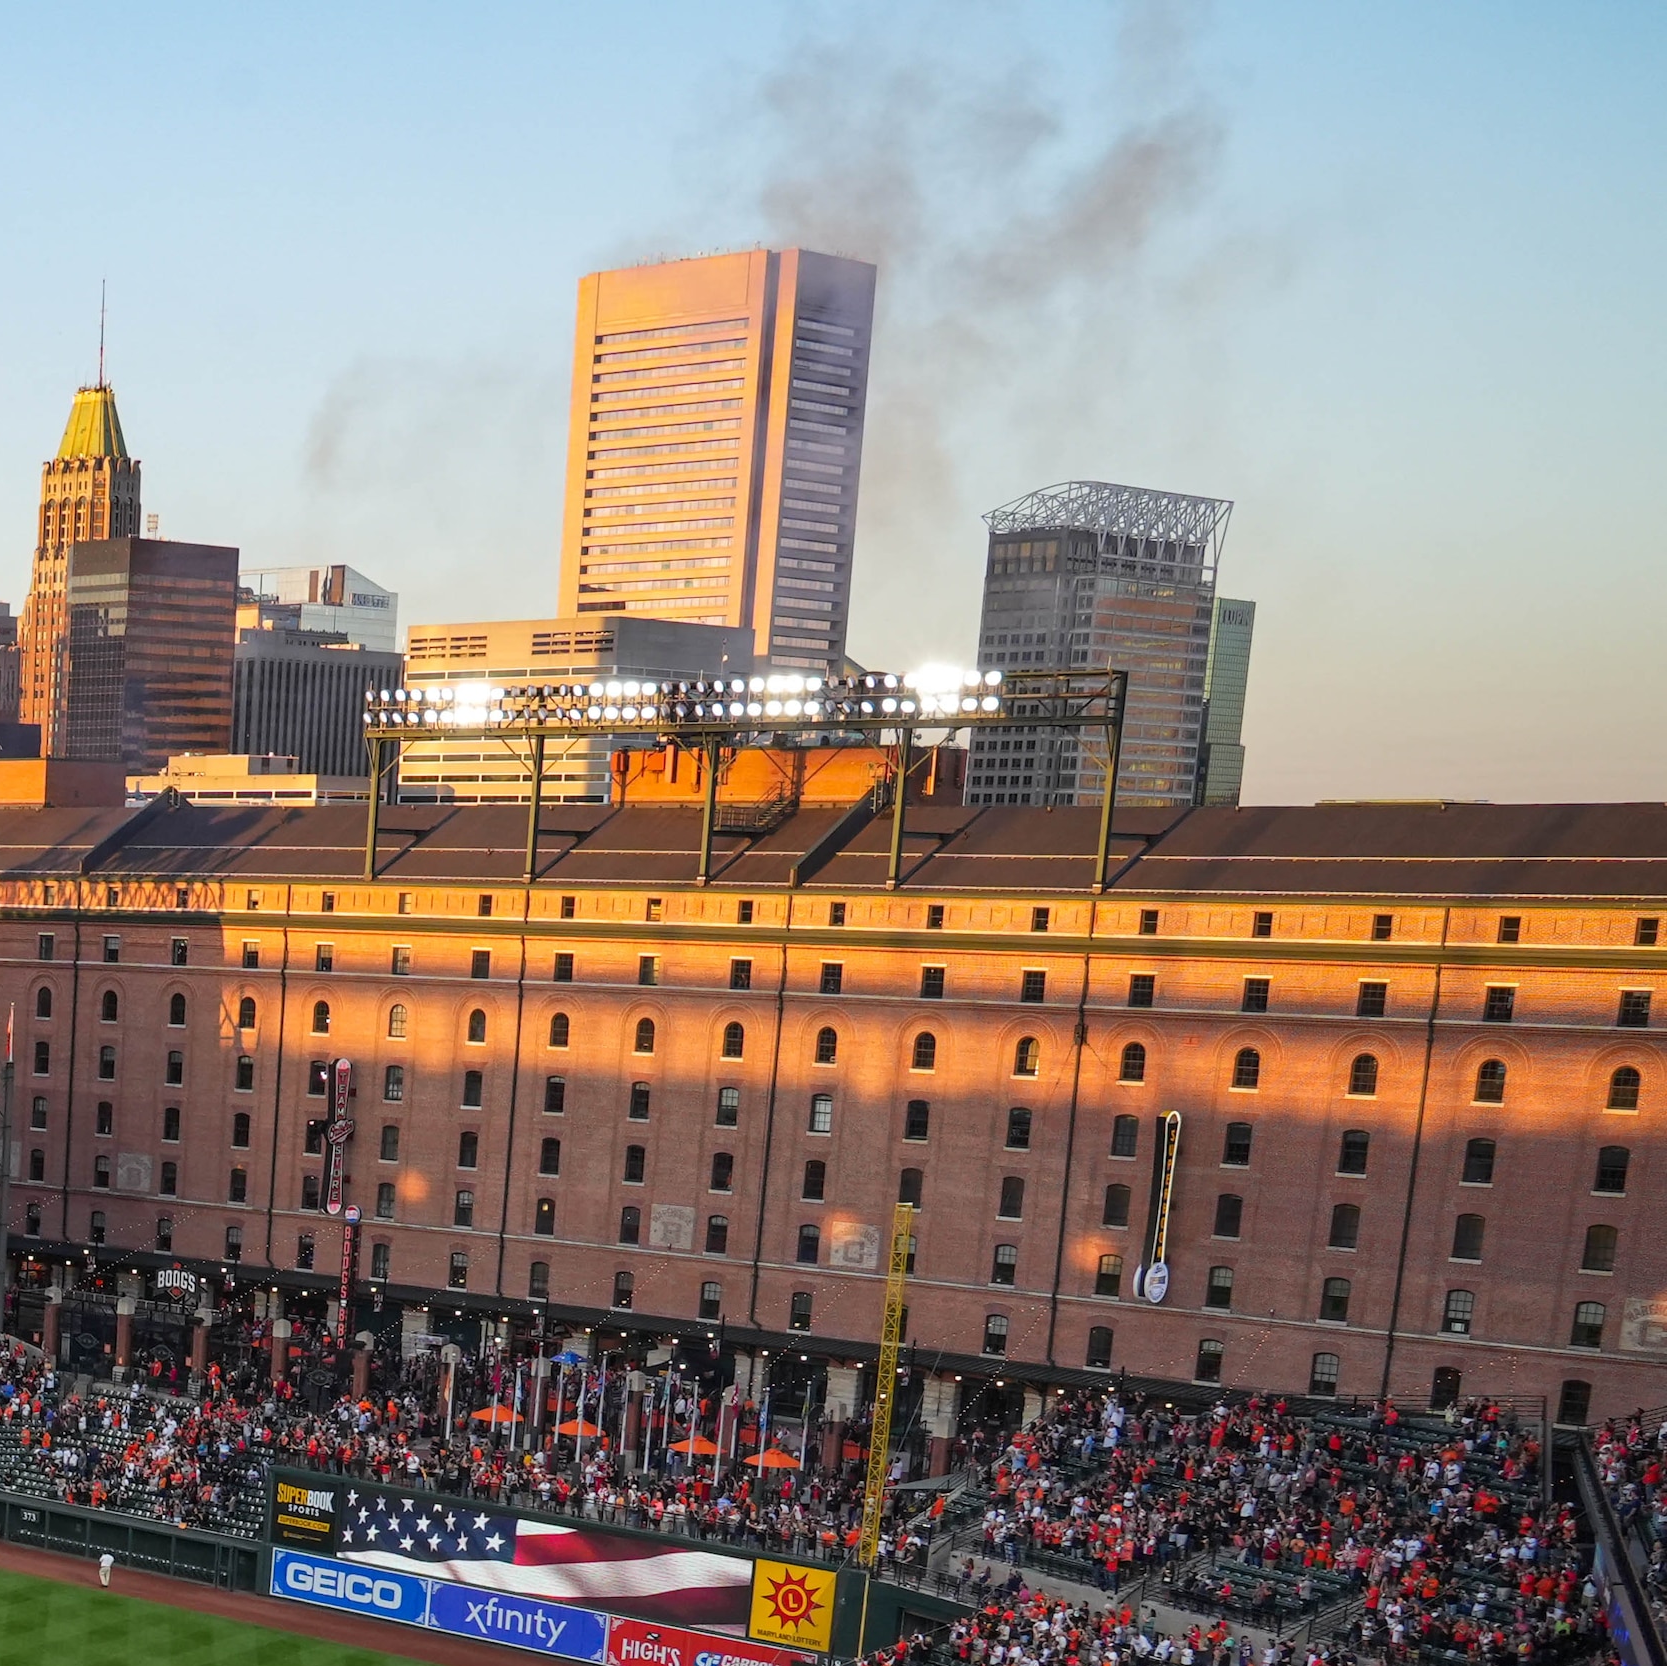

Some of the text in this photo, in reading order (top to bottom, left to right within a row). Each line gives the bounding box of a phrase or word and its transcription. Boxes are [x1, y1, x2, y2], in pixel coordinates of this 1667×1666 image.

[338, 1072, 347, 1116] TEAM
[331, 1146, 341, 1201] STORE
[277, 1482, 335, 1513] SUPERBOOK
[288, 1503, 320, 1517] SPORTS
[22, 1511, 37, 1522] 373
[279, 1516, 329, 1531] SUPERBOOK.COM
[286, 1562, 402, 1610] GEICO
[464, 1597, 567, 1648] xfinity
[757, 1628, 822, 1646] MARYLAND LOTTERY
